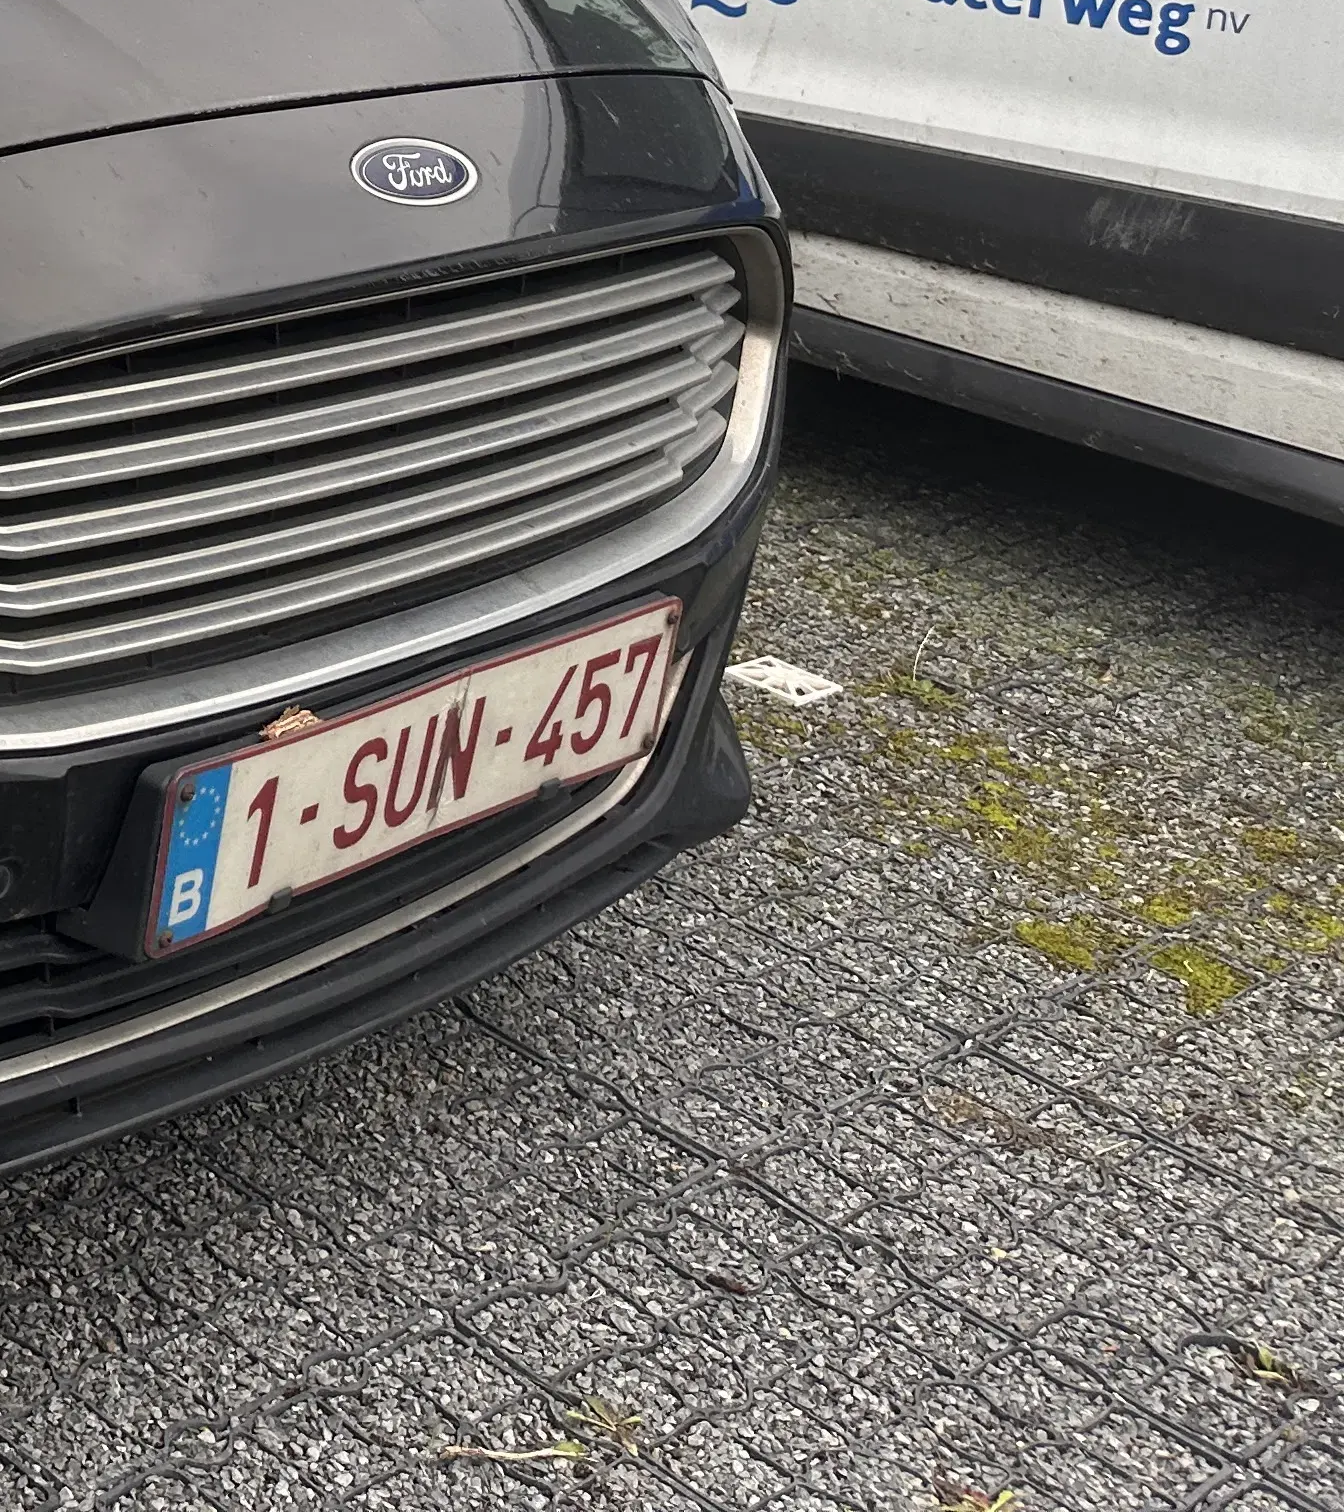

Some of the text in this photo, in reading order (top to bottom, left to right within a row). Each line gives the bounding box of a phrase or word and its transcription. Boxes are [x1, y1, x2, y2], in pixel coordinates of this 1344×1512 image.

[1206, 7, 1251, 36] nv
[382, 152, 448, 191] Ford
[246, 634, 663, 888] 1-SUN-457
[168, 868, 204, 926] B
